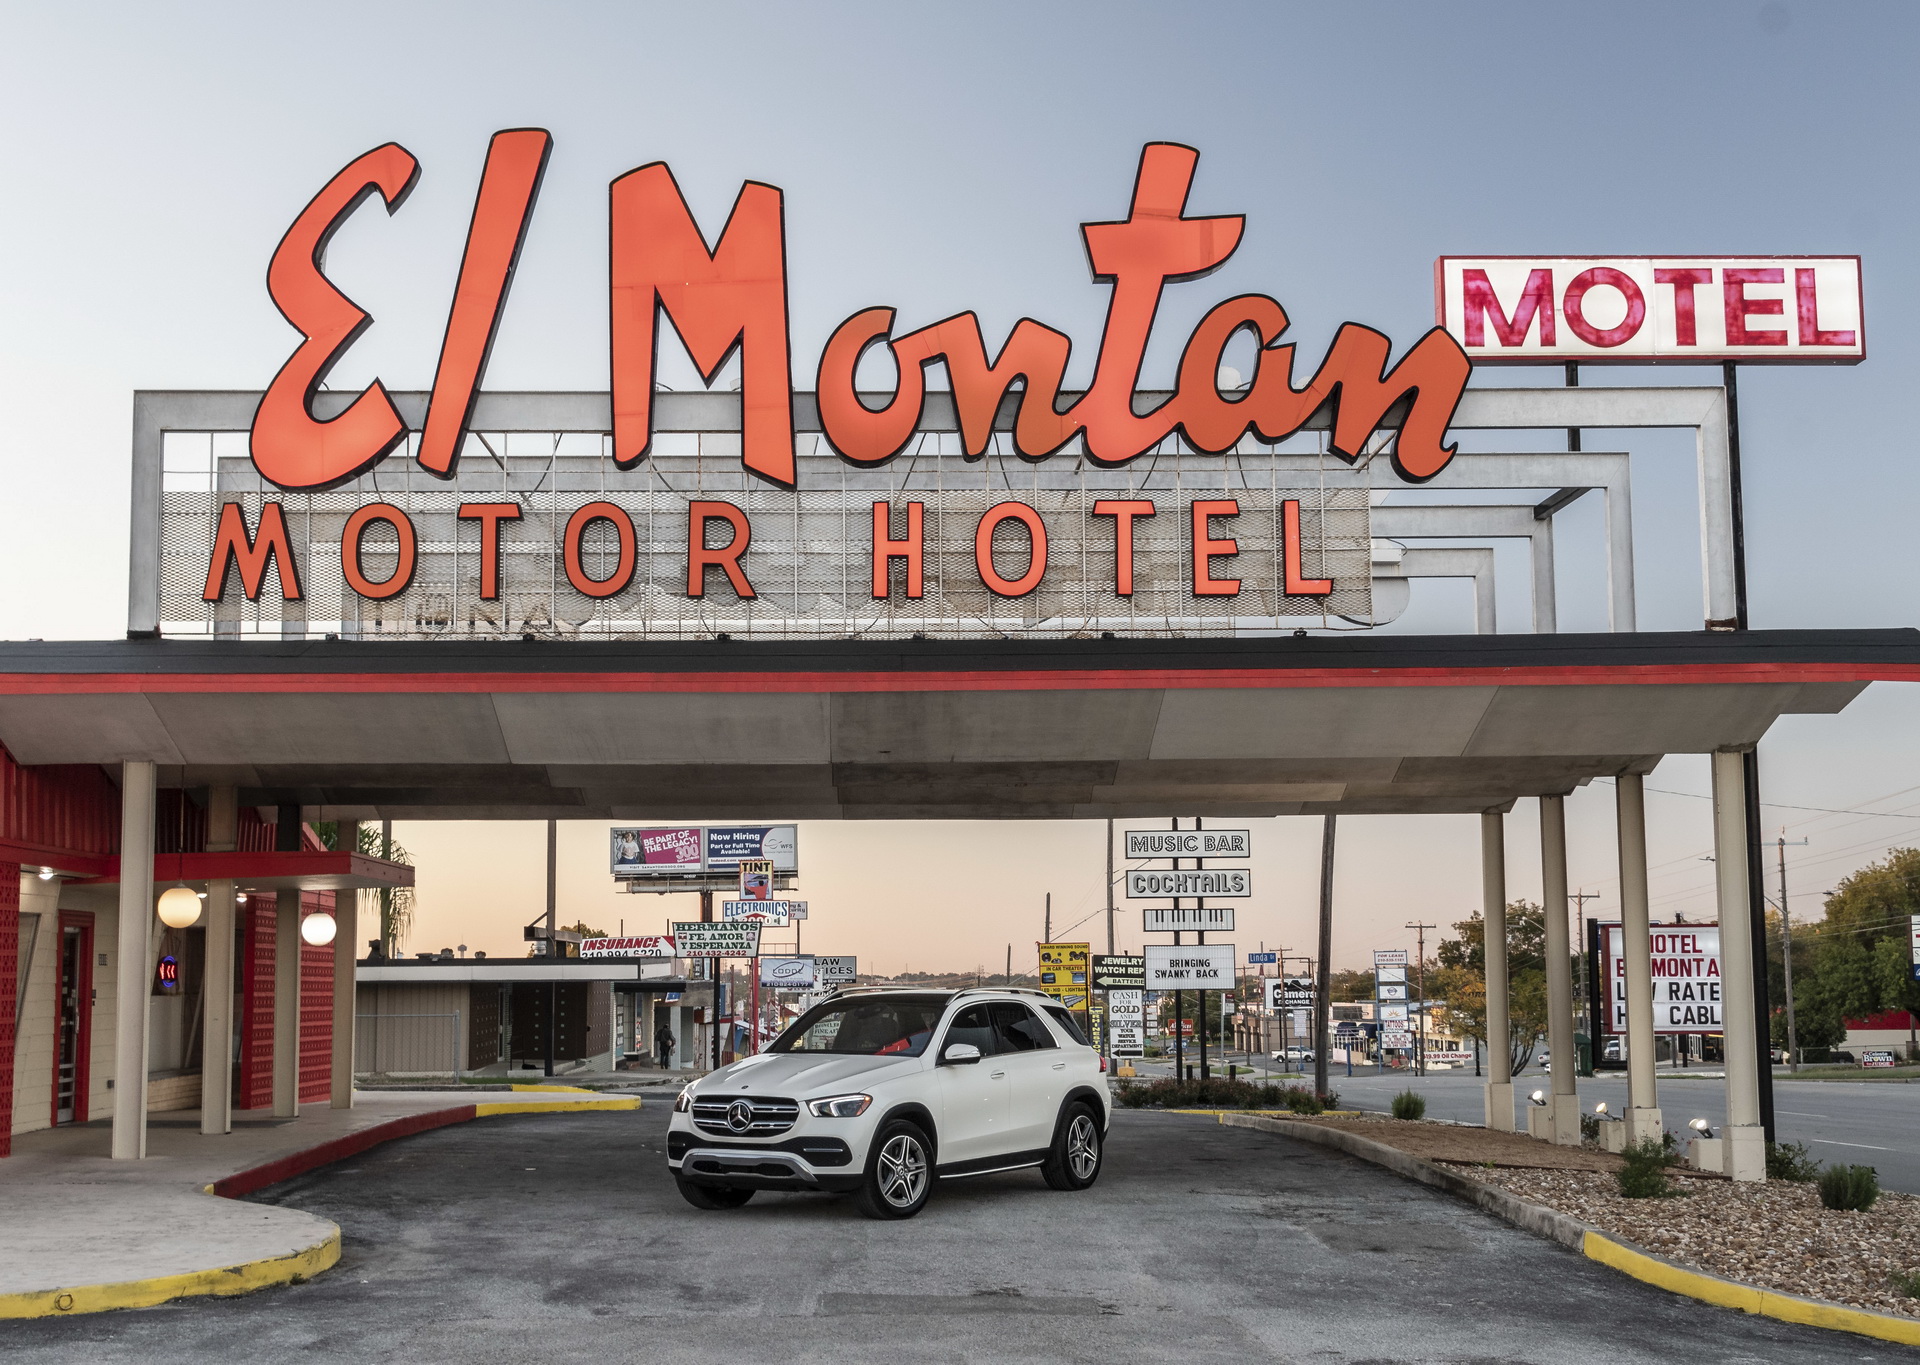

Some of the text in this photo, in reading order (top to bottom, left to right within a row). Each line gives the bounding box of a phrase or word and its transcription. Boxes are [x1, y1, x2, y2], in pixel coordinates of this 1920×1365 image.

[248, 127, 1473, 491] El Montan
[1462, 267, 1856, 348] MOTEL
[201, 500, 1335, 602] MOTOR HOTEL
[643, 830, 690, 847] BE PART OF
[710, 832, 760, 841] Now Hiring
[644, 836, 699, 854] THE LEGACY!
[1130, 834, 1245, 853] MUSIC BAR
[674, 843, 699, 860] 300
[742, 862, 771, 872] TINT
[1132, 873, 1244, 893] COCKTAILS
[724, 902, 788, 917] ELECTRONICS
[675, 923, 759, 932] HERMANOS
[688, 933, 744, 941] FE, AMOR
[581, 936, 661, 951] INSURANCE
[681, 941, 752, 950] Y ESPERANZA
[814, 958, 840, 966] LAW
[1102, 957, 1144, 965] JEWELRY
[1250, 953, 1268, 962] Linda
[1169, 958, 1211, 968] BRINGING
[1651, 958, 1720, 977] MONTA
[825, 967, 853, 975] ICES
[1094, 966, 1144, 975] WATCH REP
[1154, 968, 1219, 979] SWANKY BACK
[1112, 991, 1138, 1000] CASH
[1668, 981, 1720, 1001] RATE
[1111, 1005, 1140, 1014] GOLD
[1669, 1005, 1722, 1025] CABL
[1110, 1019, 1143, 1028] SILVER
